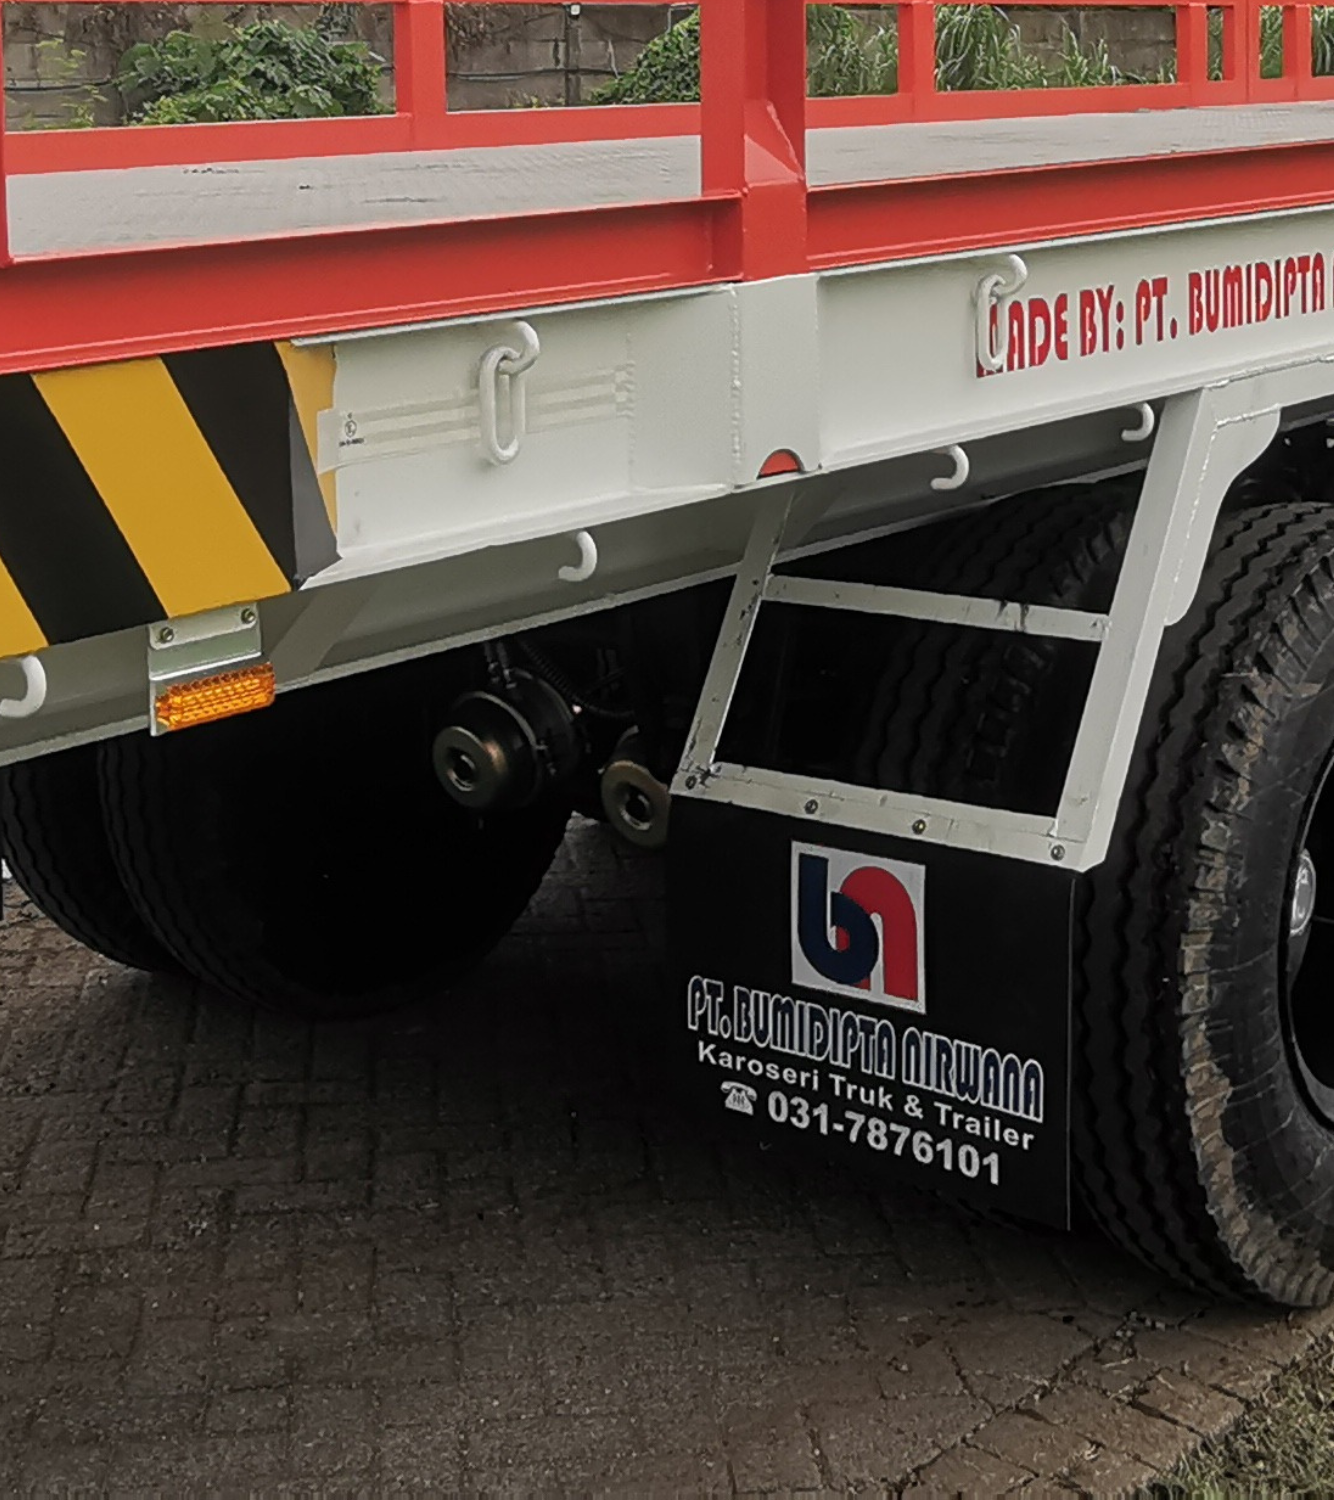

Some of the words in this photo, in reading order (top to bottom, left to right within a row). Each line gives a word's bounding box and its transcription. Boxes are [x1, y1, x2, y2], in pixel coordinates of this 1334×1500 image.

[1080, 285, 1124, 356] BY:
[1135, 276, 1178, 346] PT.
[1188, 252, 1326, 336] BUMIDIPTA
[687, 975, 732, 1038] PT.
[733, 986, 896, 1080] BUMIDIPTA
[902, 1027, 1044, 1123] NIRWANA
[698, 1041, 819, 1090] Karoseri
[829, 1073, 893, 1111] Truk
[904, 1095, 925, 1119] &
[933, 1101, 1035, 1151] Trailer
[767, 1091, 1000, 1186] 031-7876101
